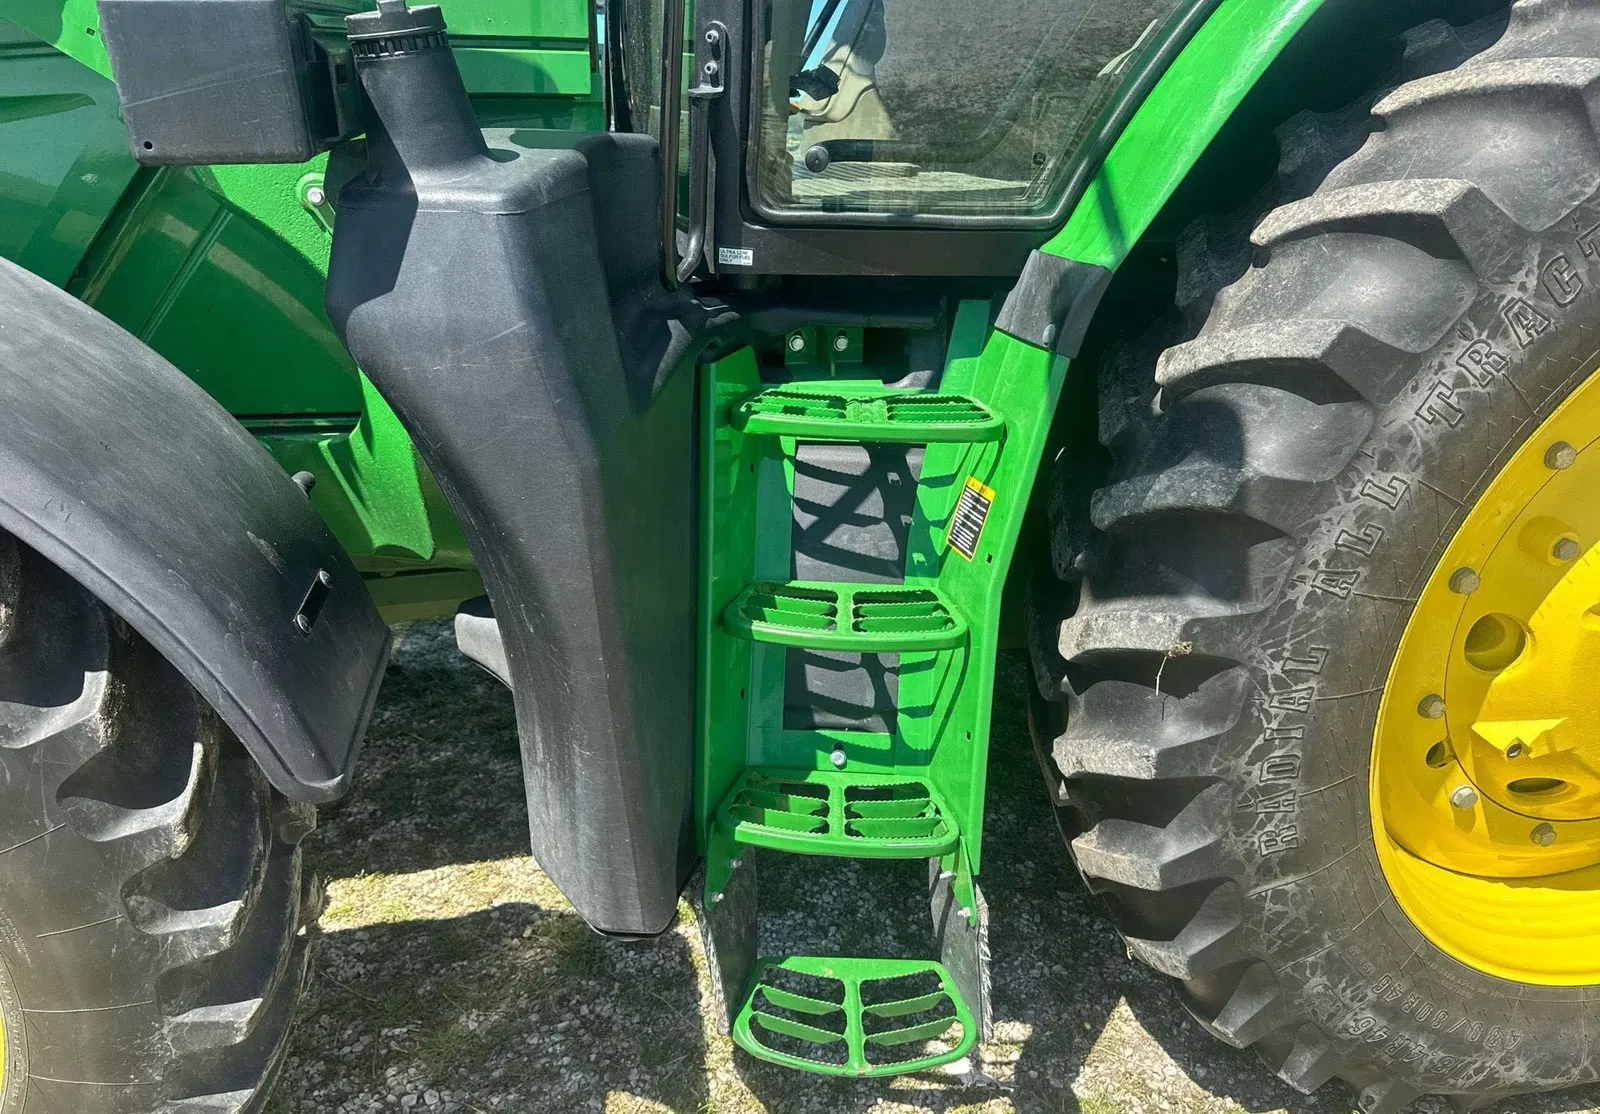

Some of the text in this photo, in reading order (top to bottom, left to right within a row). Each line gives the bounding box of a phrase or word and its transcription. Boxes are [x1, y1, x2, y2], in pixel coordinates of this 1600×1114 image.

[1255, 645, 1329, 857] RADIAL
[1310, 475, 1410, 599] ALL
[1371, 973, 1523, 1050] 480/80R46
